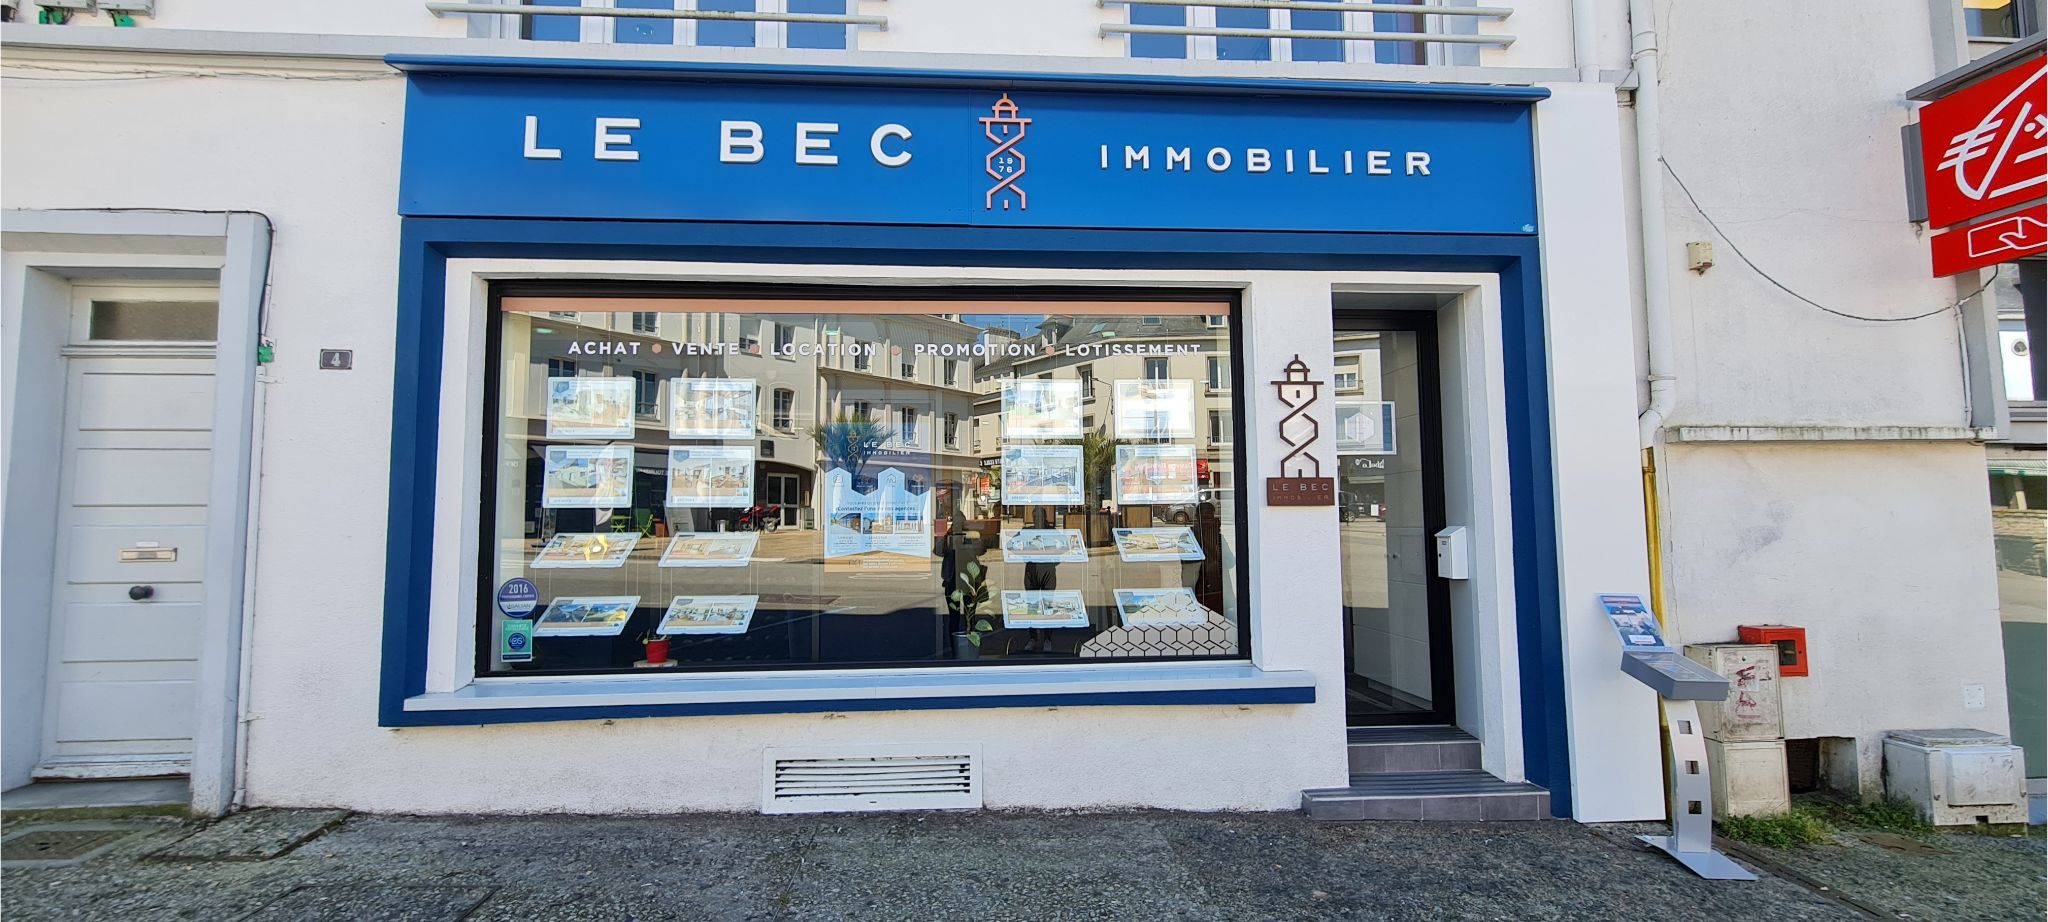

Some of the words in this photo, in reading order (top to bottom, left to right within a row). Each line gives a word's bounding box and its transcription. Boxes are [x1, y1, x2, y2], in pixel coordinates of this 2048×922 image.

[522, 115, 641, 162] LE
[719, 120, 913, 168] BEC
[998, 157, 1013, 165] 19
[1100, 144, 1432, 176] IMMOBILIER
[998, 165, 1013, 173] 76
[568, 341, 641, 355] ACHAT
[672, 342, 739, 356] VENTE
[770, 342, 877, 357] LOCATION
[914, 343, 1036, 357] PROMOTION
[1065, 344, 1201, 358] LOTISSEMENT
[331, 352, 341, 367] 4
[1272, 483, 1289, 491] LE
[1300, 483, 1329, 491] BEC
[508, 584, 529, 594] 2016
